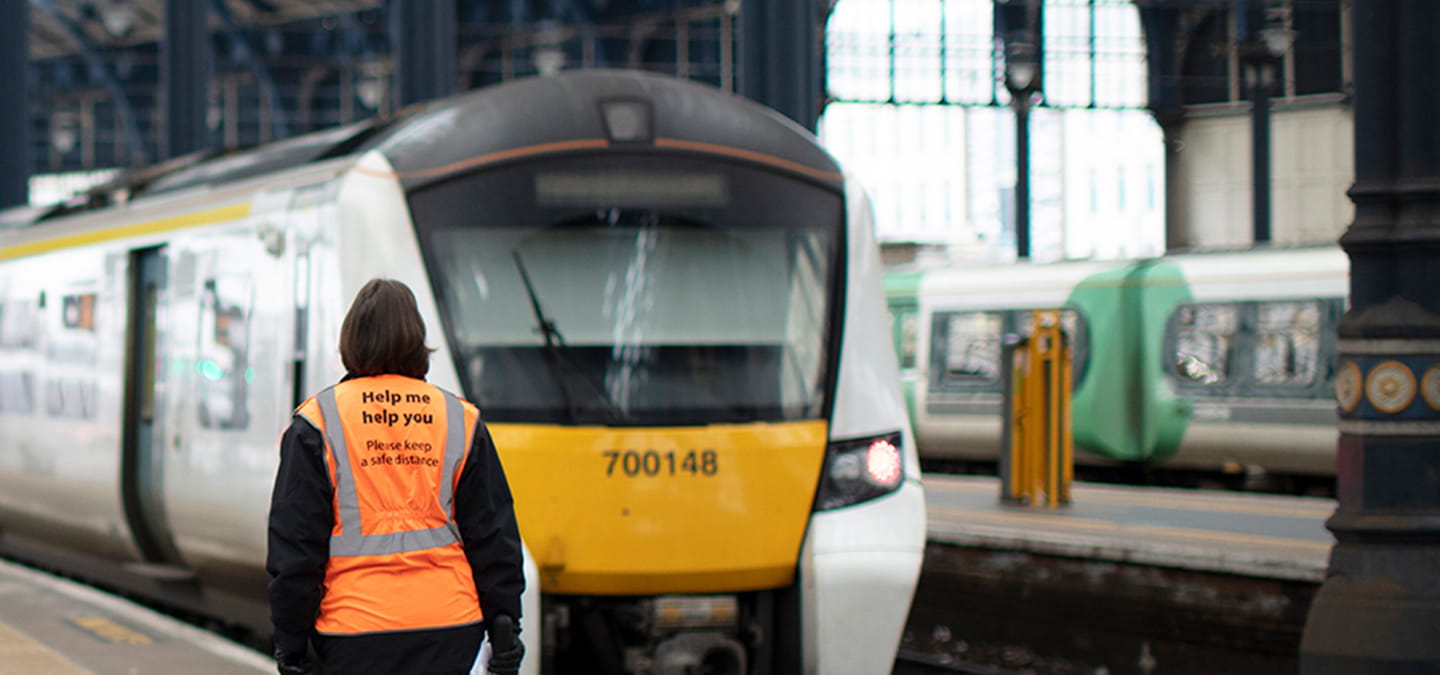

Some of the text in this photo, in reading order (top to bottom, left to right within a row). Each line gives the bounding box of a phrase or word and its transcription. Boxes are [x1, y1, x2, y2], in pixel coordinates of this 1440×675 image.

[362, 389, 431, 406] Help me
[362, 409, 433, 427] help you
[404, 440, 432, 452] keep
[361, 453, 439, 467] a safe distance
[603, 450, 718, 477] 700148
